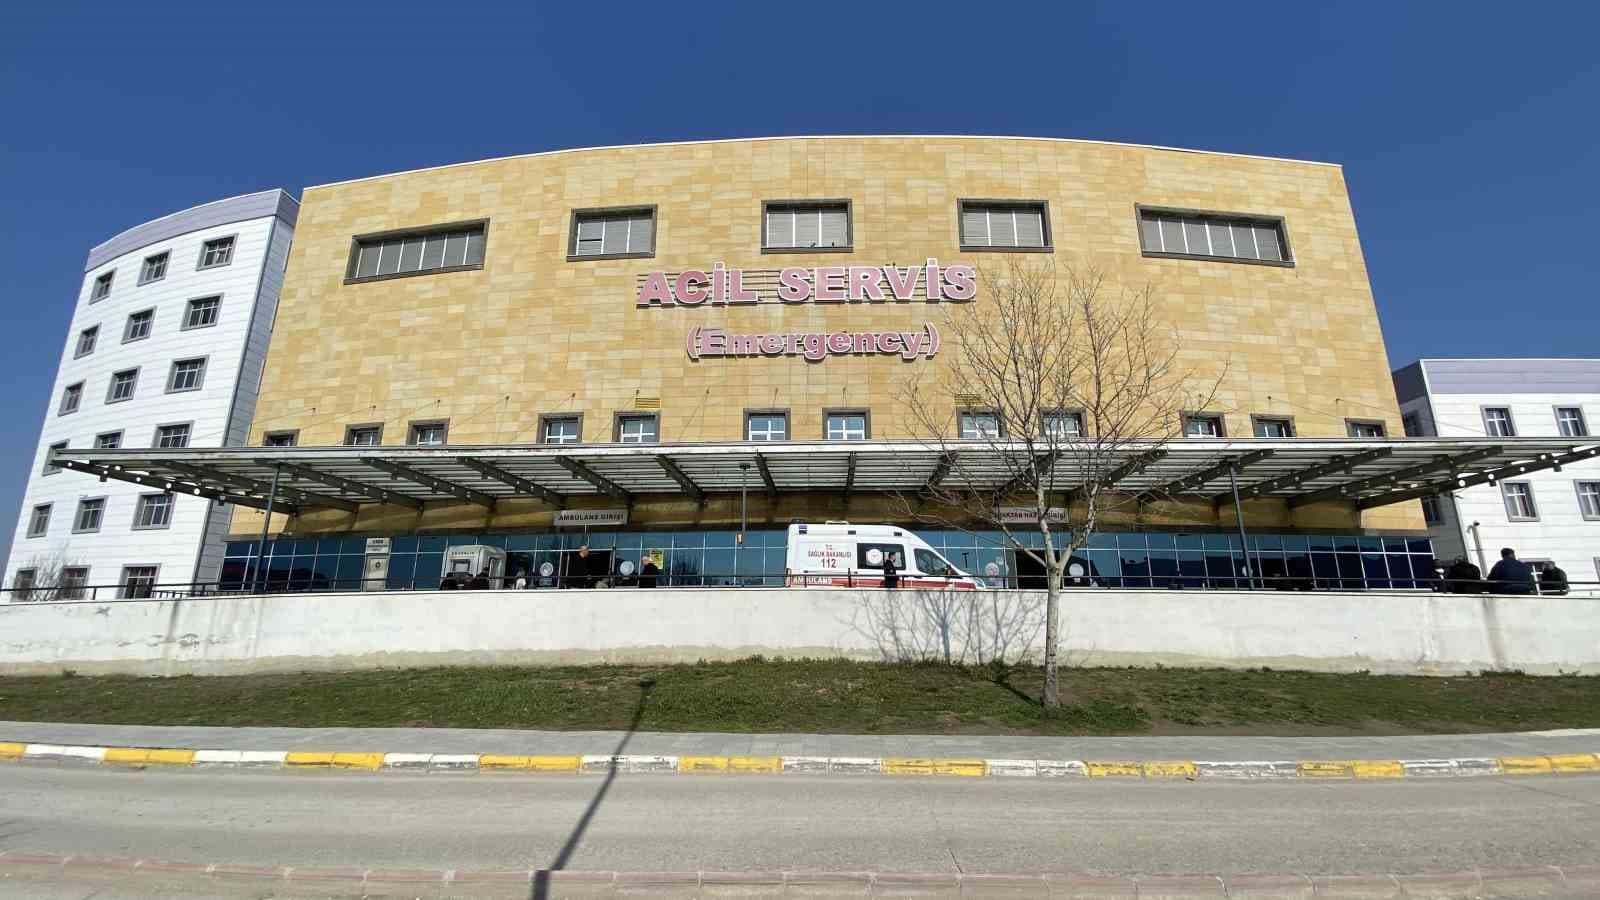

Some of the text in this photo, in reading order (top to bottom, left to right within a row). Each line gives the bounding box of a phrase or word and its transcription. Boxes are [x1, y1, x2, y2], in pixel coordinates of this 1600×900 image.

[638, 258, 977, 304] ACİL SERVİS
[686, 321, 941, 360] (Emergency)
[821, 559, 837, 568] 112
